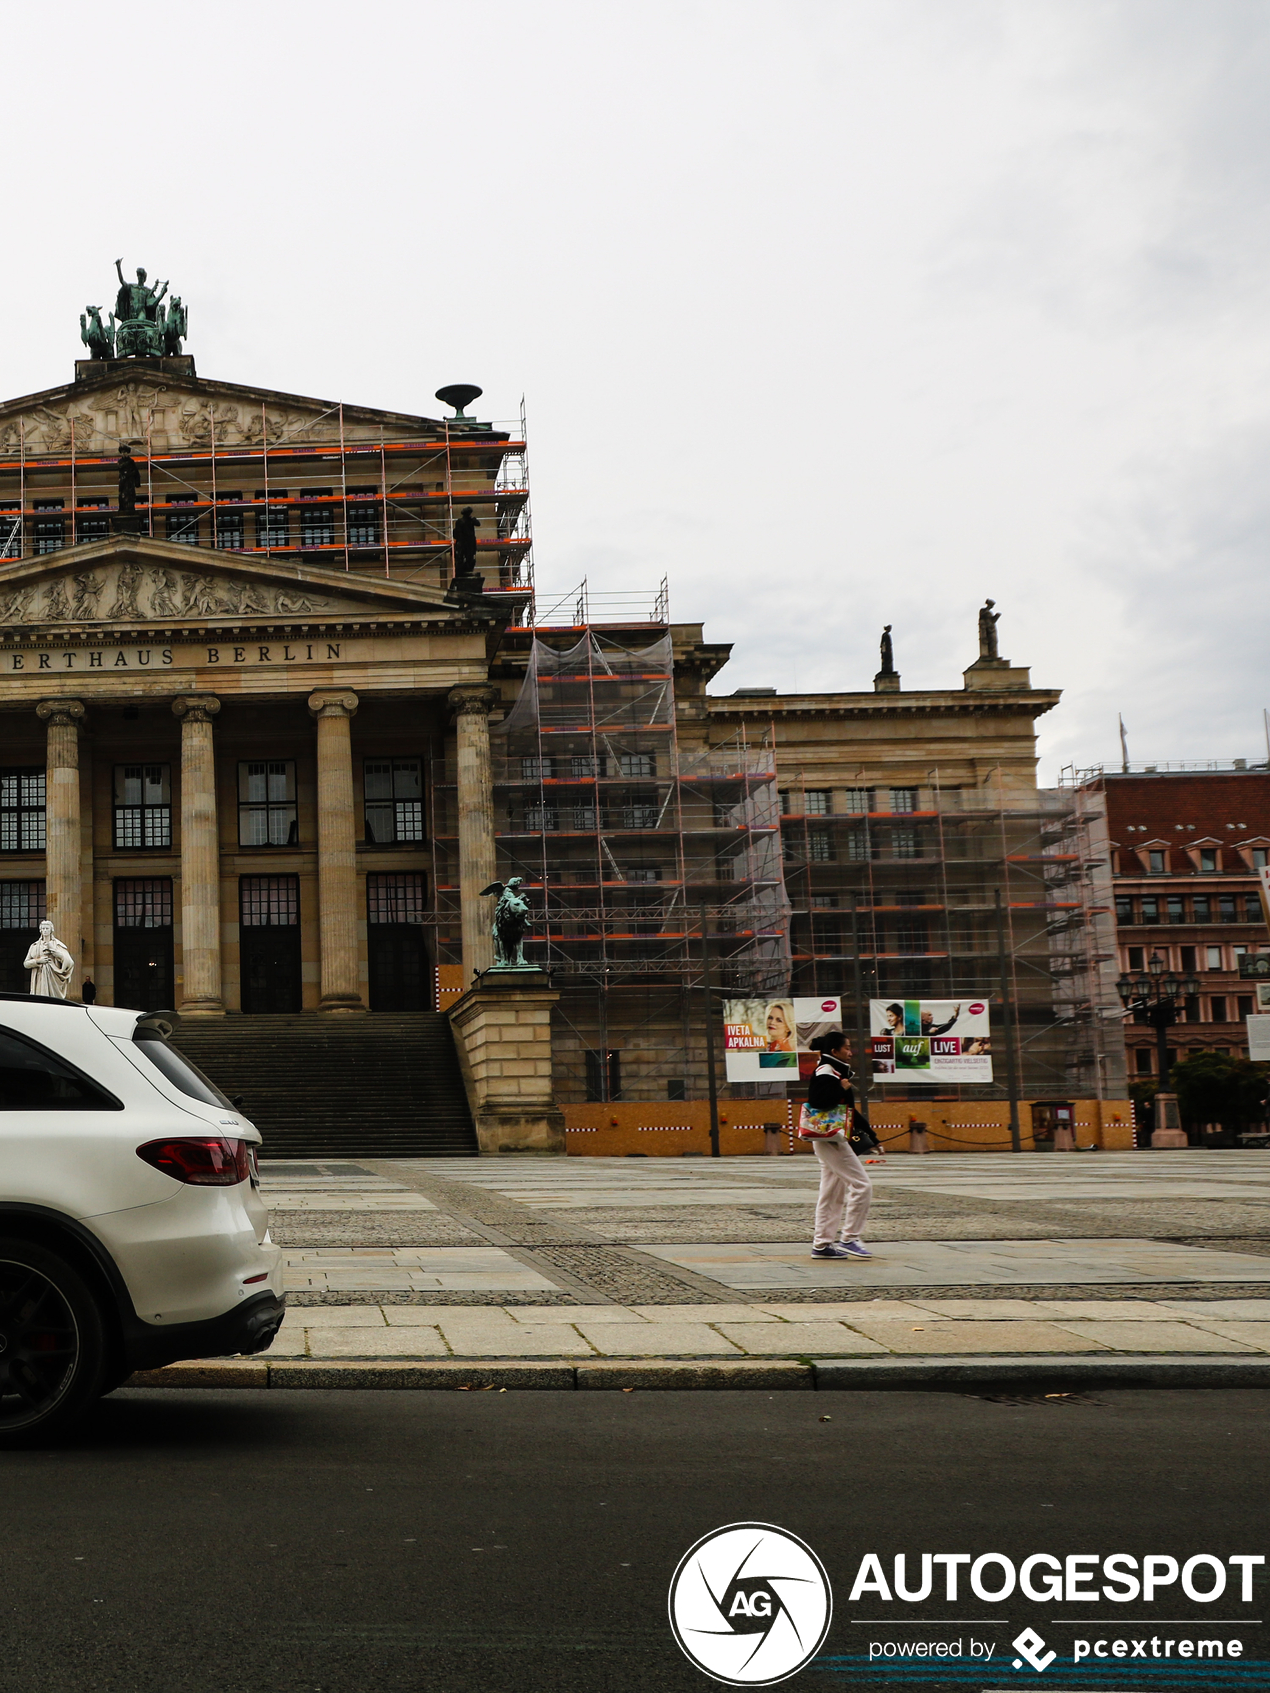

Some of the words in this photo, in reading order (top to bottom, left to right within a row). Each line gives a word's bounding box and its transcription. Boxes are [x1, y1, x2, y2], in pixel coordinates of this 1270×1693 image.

[207, 643, 341, 663] BERLIN
[727, 1025, 750, 1036] IVETA
[728, 1036, 765, 1048] APKALNA
[874, 1044, 891, 1053] LUST
[902, 1041, 924, 1056] auf
[934, 1041, 957, 1053] LIVE
